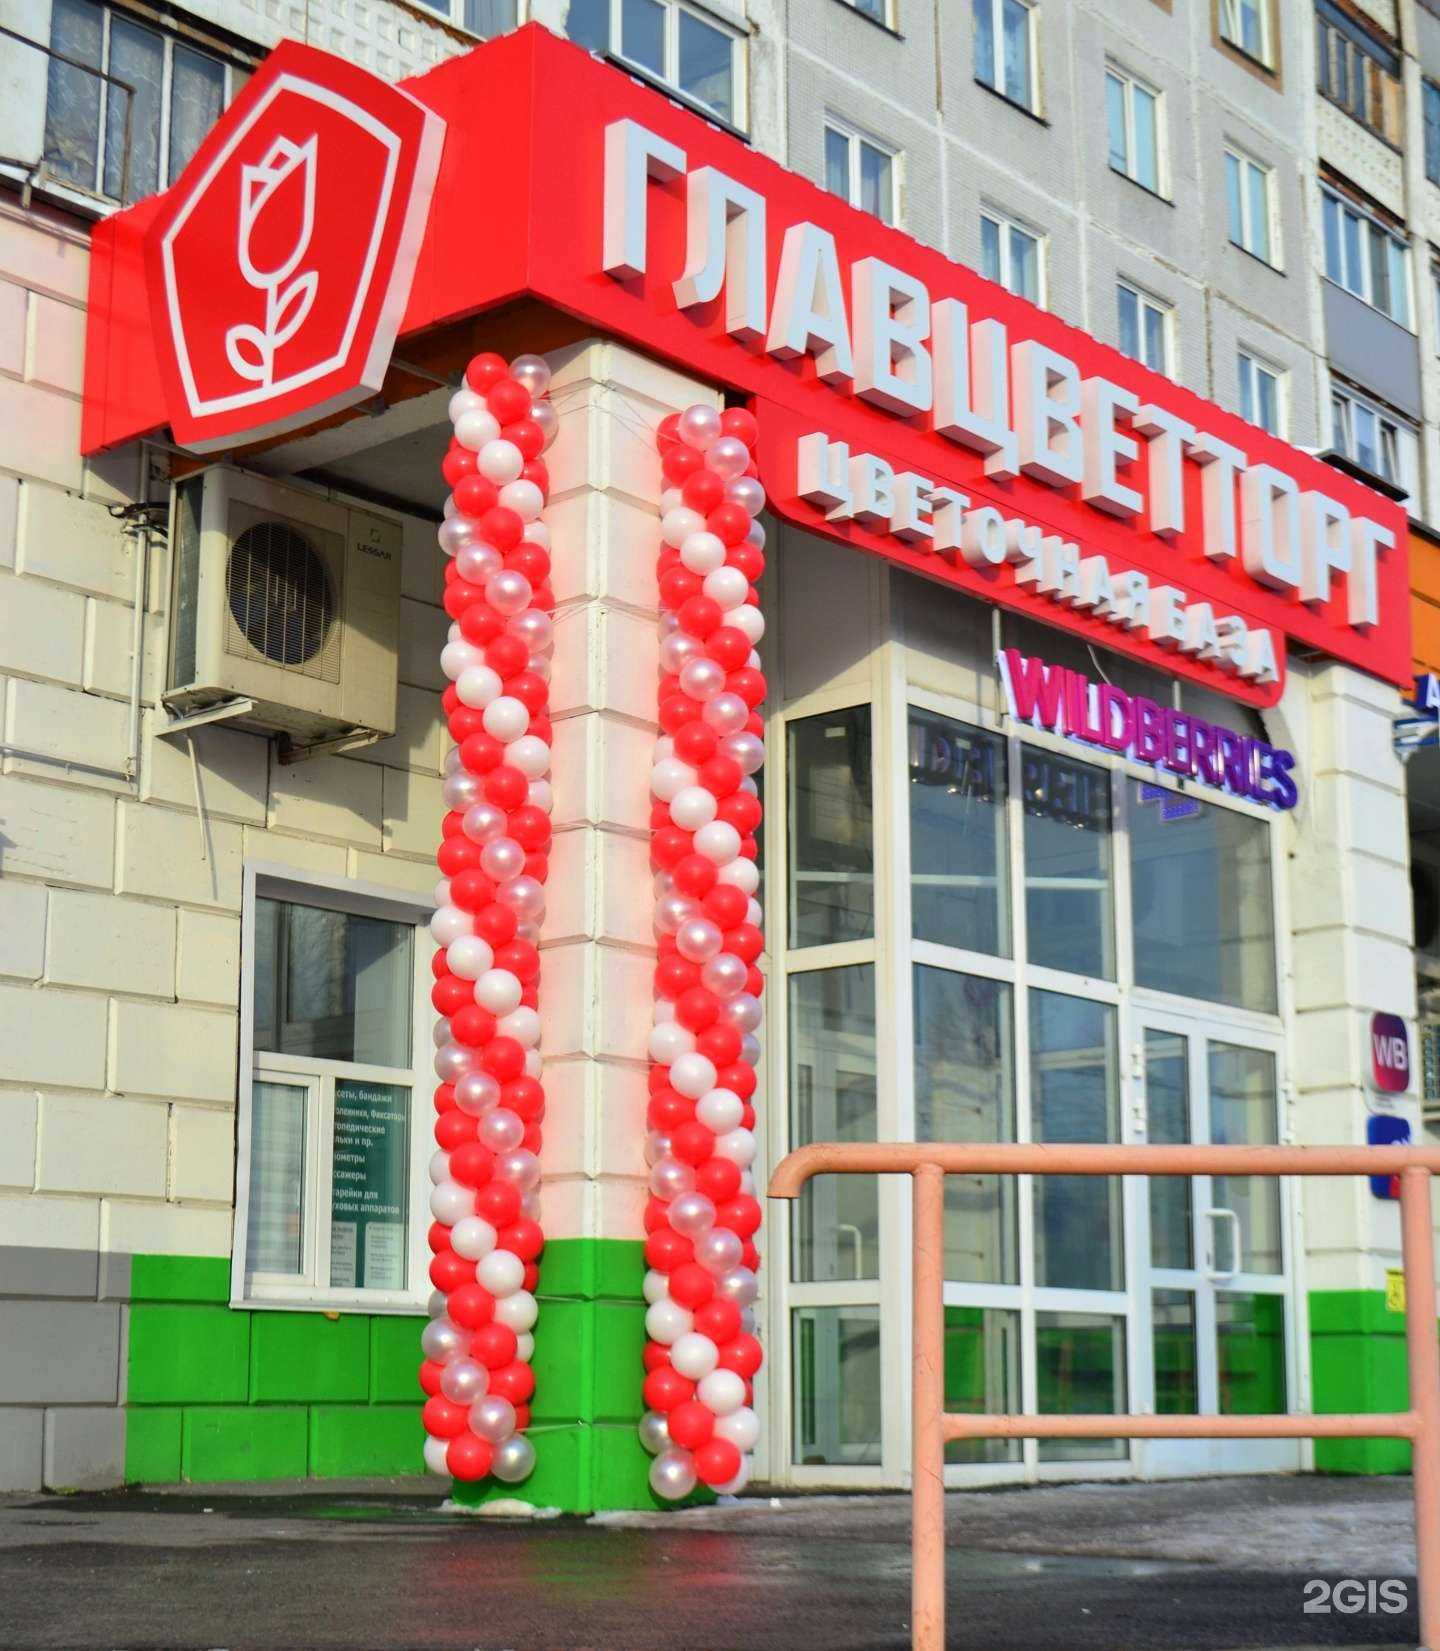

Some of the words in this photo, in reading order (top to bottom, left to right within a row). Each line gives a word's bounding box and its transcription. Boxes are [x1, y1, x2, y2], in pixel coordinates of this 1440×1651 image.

[603, 118, 1396, 628] ГЛАВЦВЕТТОРГ
[798, 432, 1149, 628] ЦВЕТОЧНАЯ
[1148, 585, 1279, 684] БАЗА
[998, 648, 1298, 811] WILDBERRIES
[1374, 1034, 1408, 1071] WB
[359, 1090, 392, 1103] бандажи
[361, 1203, 399, 1215] аппаратов
[363, 1191, 378, 1201] для
